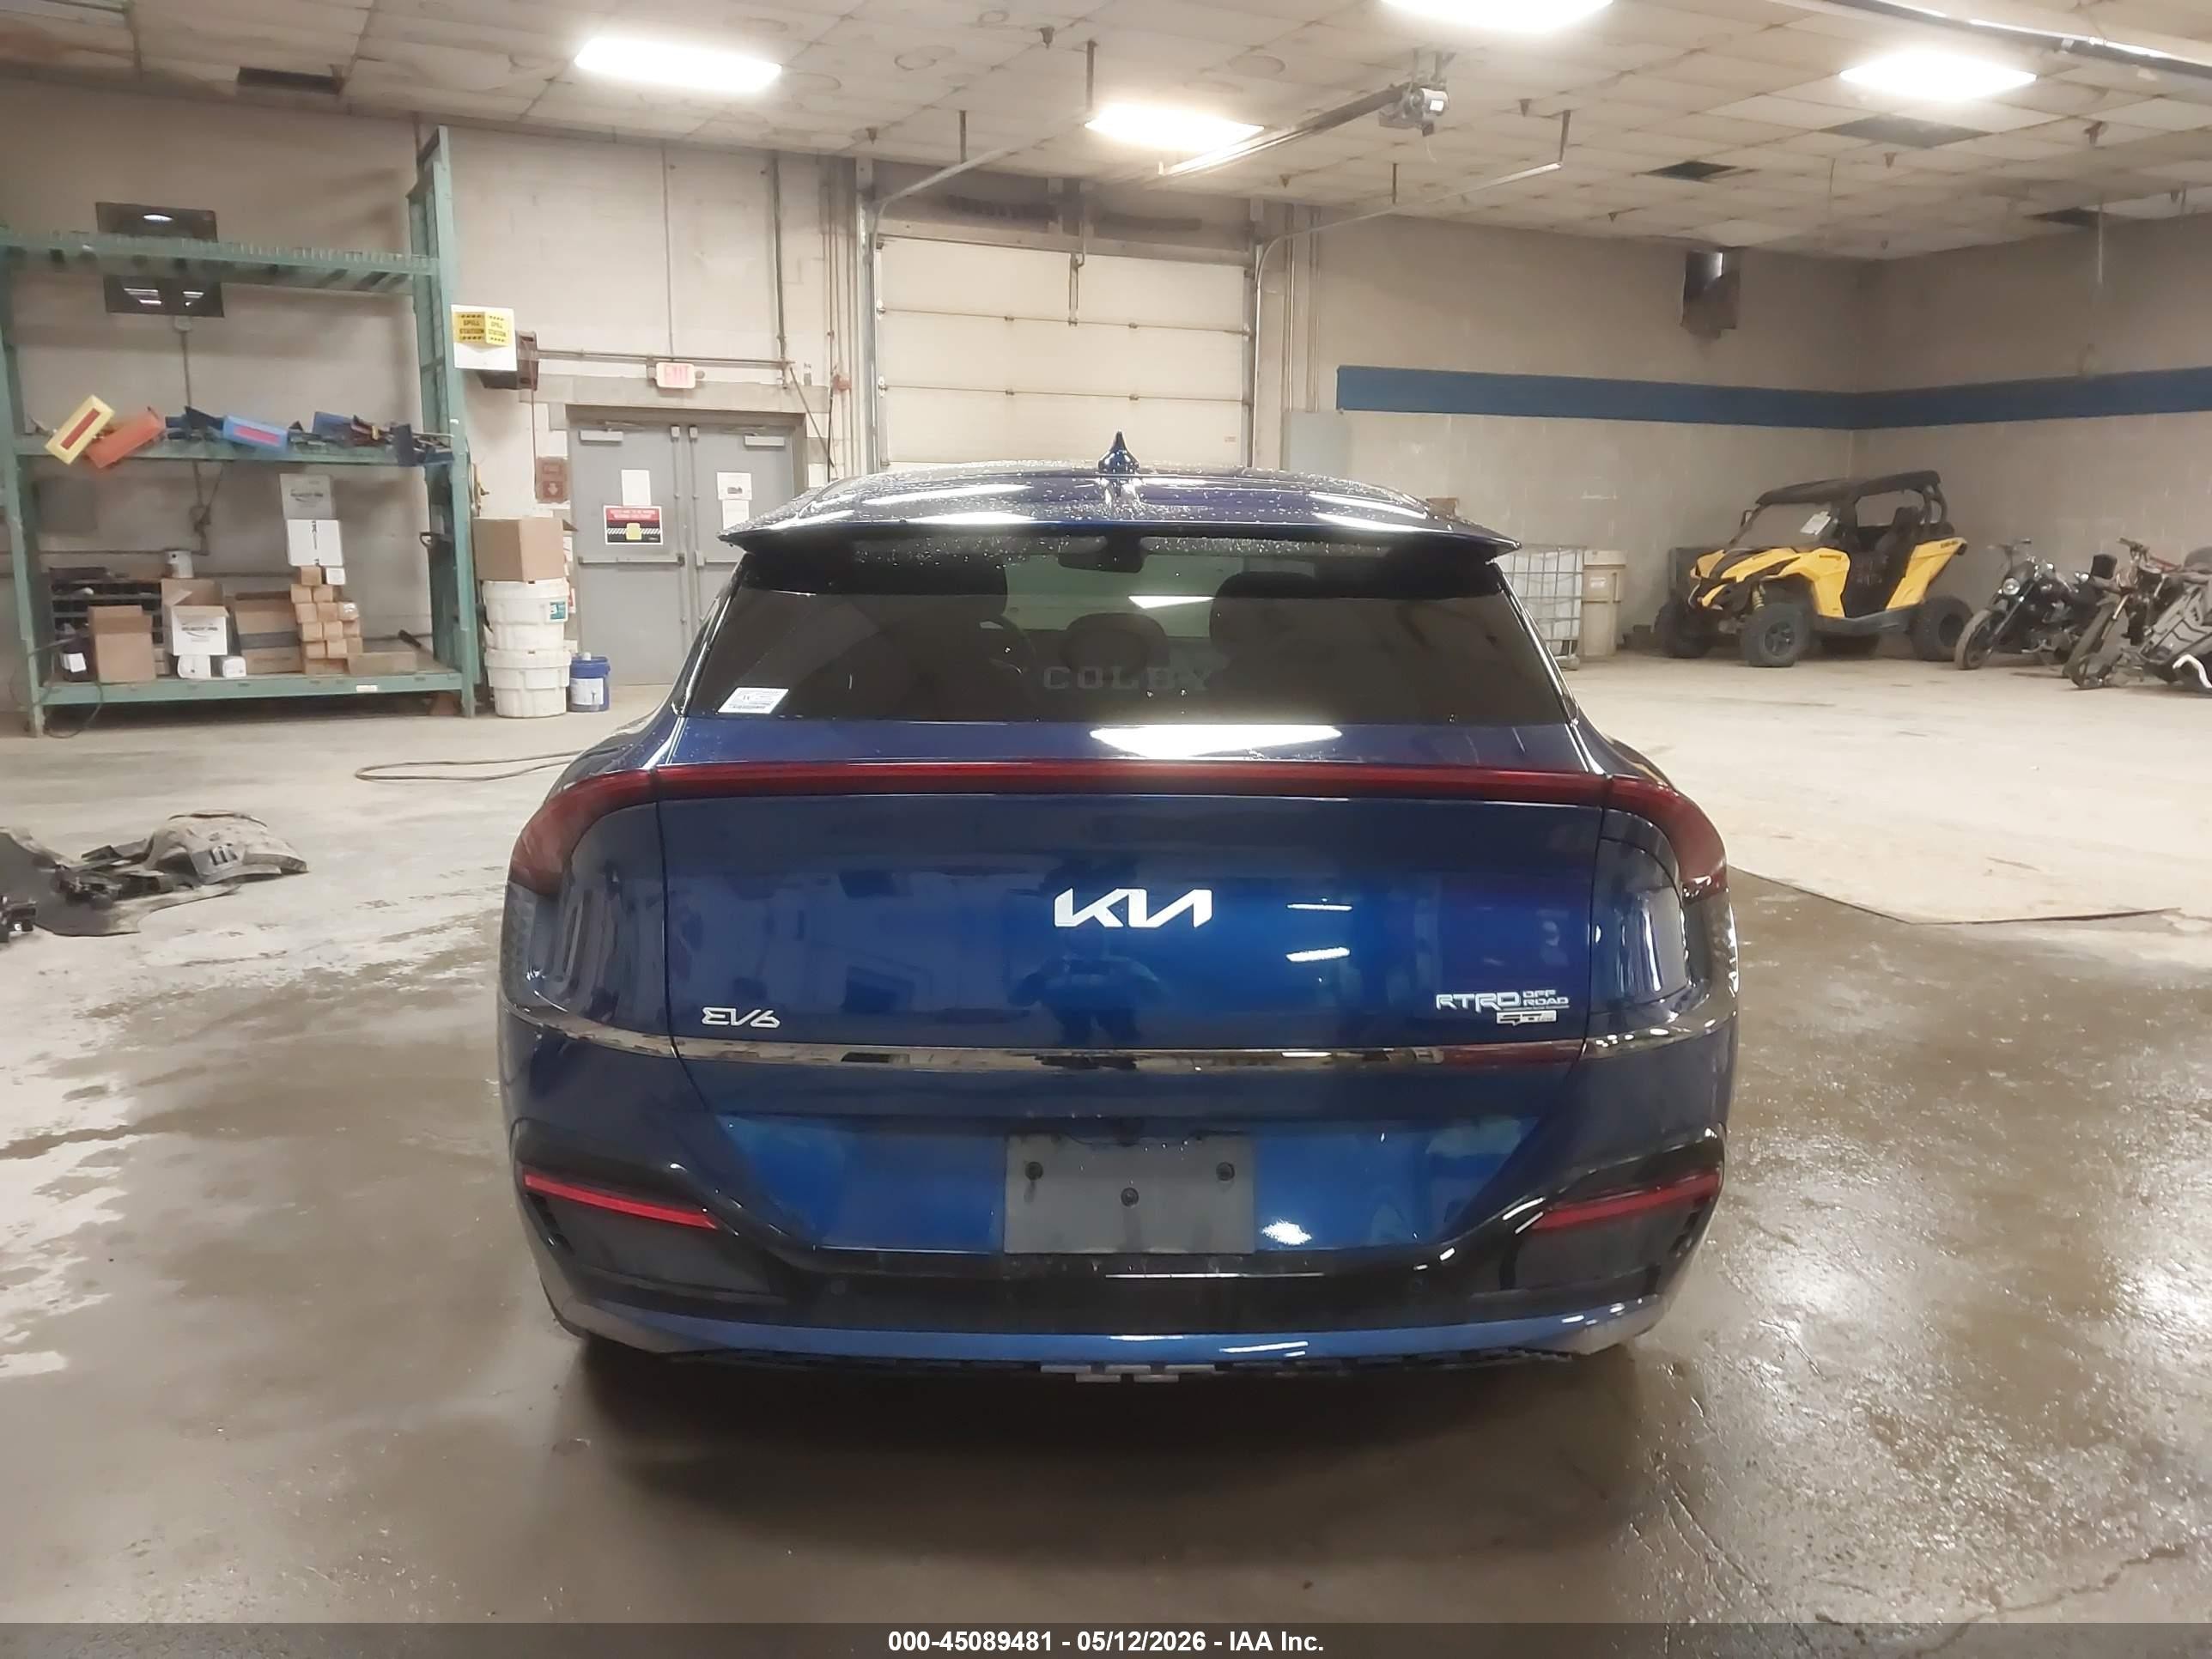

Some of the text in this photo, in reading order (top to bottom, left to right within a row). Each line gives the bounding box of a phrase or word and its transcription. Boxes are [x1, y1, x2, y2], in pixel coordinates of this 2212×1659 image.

[1054, 888, 1212, 928] KIA
[1522, 989, 1556, 998] OFF
[1523, 997, 1570, 1006] ROAD
[702, 1006, 781, 1029] EV6
